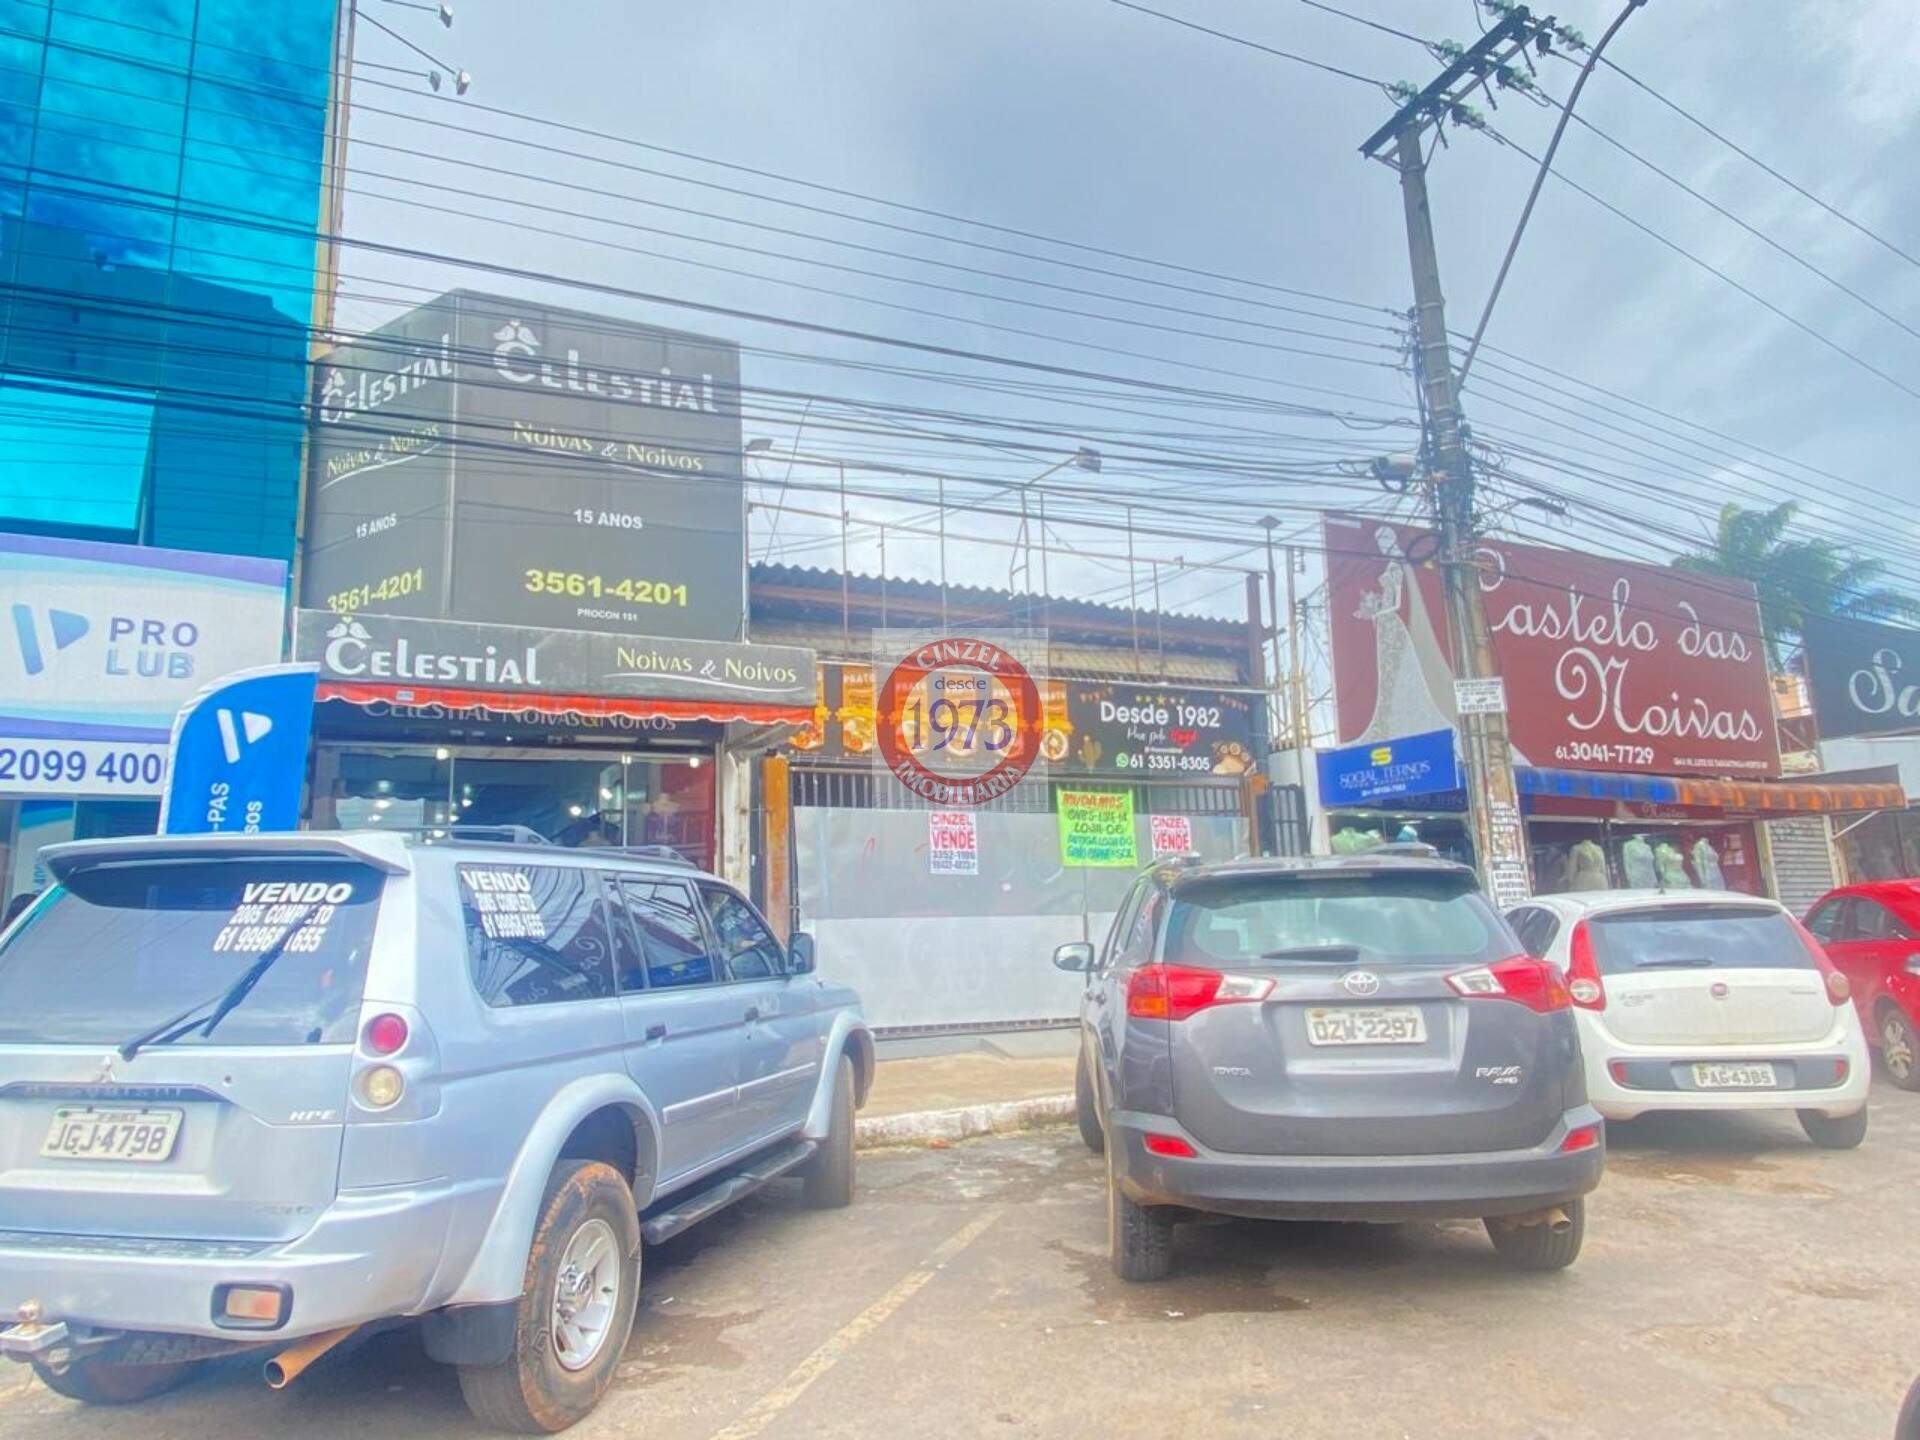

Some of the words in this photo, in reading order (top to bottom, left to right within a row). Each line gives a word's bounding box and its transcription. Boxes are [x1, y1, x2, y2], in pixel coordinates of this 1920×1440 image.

[601, 442, 618, 458] &
[356, 523, 367, 538] 15
[368, 513, 397, 534] ANOS
[574, 509, 594, 524] 15
[597, 512, 643, 529] ANOS
[327, 567, 423, 613] 3561-4201
[525, 568, 688, 606] 3561-4201
[577, 607, 620, 620] PROCON
[109, 617, 198, 647] PRO
[1677, 600, 1752, 662] das
[105, 648, 195, 679] LUB
[700, 658, 722, 681] &
[1555, 647, 1763, 742] Noivas
[1100, 701, 1169, 724] Desde
[1176, 706, 1221, 727] 1982
[0, 748, 87, 782] 2099
[95, 751, 168, 784] 400
[1130, 753, 1144, 768] 61
[931, 813, 973, 826] CINZEL
[1151, 816, 1187, 828] CINZEL
[932, 830, 976, 850] VENDE
[1153, 831, 1189, 850] VENDE
[242, 882, 353, 903] VENDO
[461, 870, 531, 893] VENDO
[213, 927, 237, 951] 61
